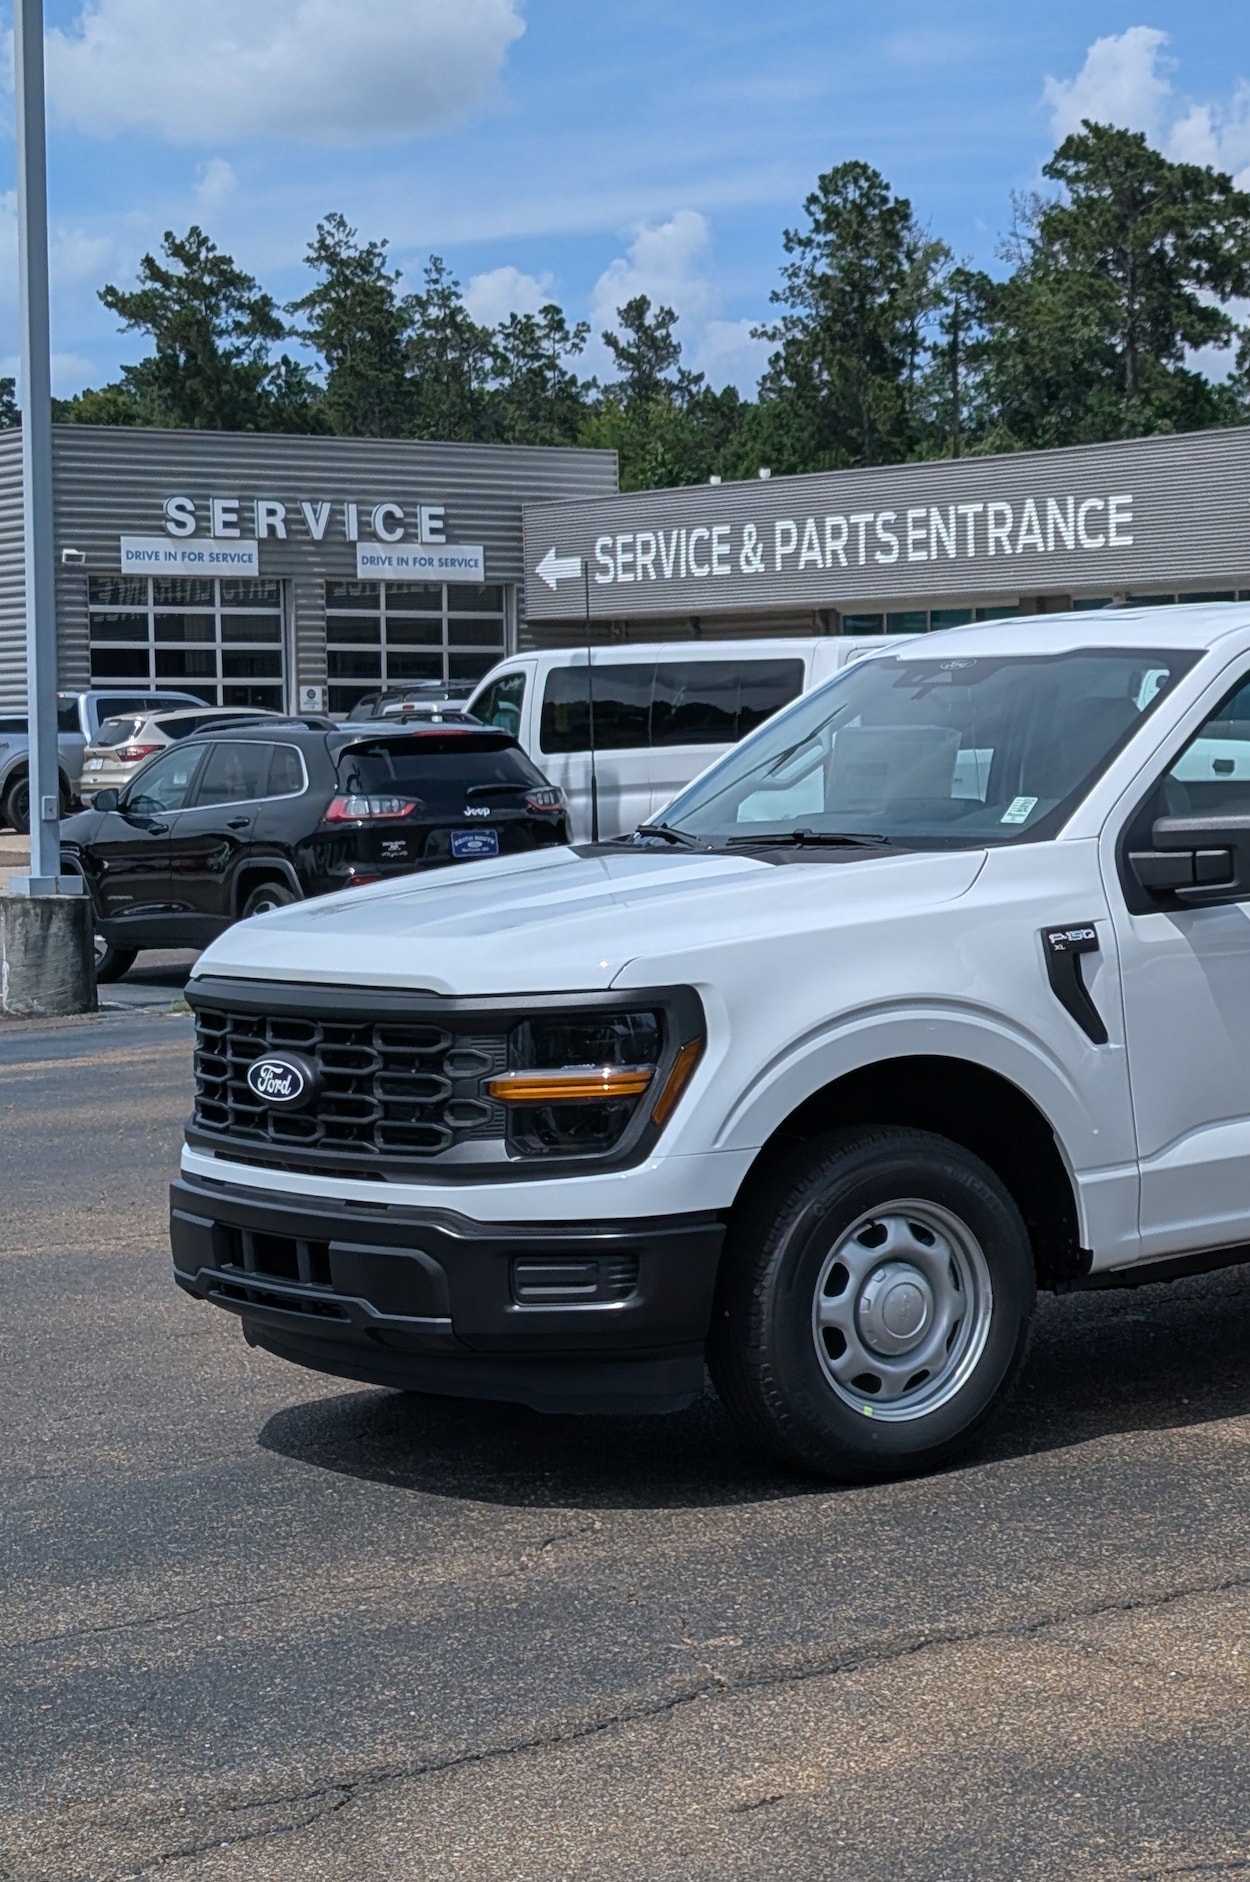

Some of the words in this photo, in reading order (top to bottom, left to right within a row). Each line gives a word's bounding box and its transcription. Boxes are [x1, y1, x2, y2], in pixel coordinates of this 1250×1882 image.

[164, 496, 447, 544] SERVICE
[594, 525, 731, 583] SERVICE
[740, 523, 765, 573] &
[774, 511, 900, 572] PARTS
[907, 494, 1133, 562] ENTRANCE
[126, 550, 161, 561] DRIVE
[164, 551, 178, 561] IN
[181, 551, 205, 562] FOR
[208, 552, 254, 564] SERVICE
[361, 555, 393, 566] DRIVE
[396, 556, 409, 567] IN
[412, 557, 435, 568] FOR
[437, 557, 480, 569] SERVICE
[464, 806, 490, 817] Jeep
[1049, 929, 1095, 943] F-150
[258, 1065, 292, 1095] Ford
